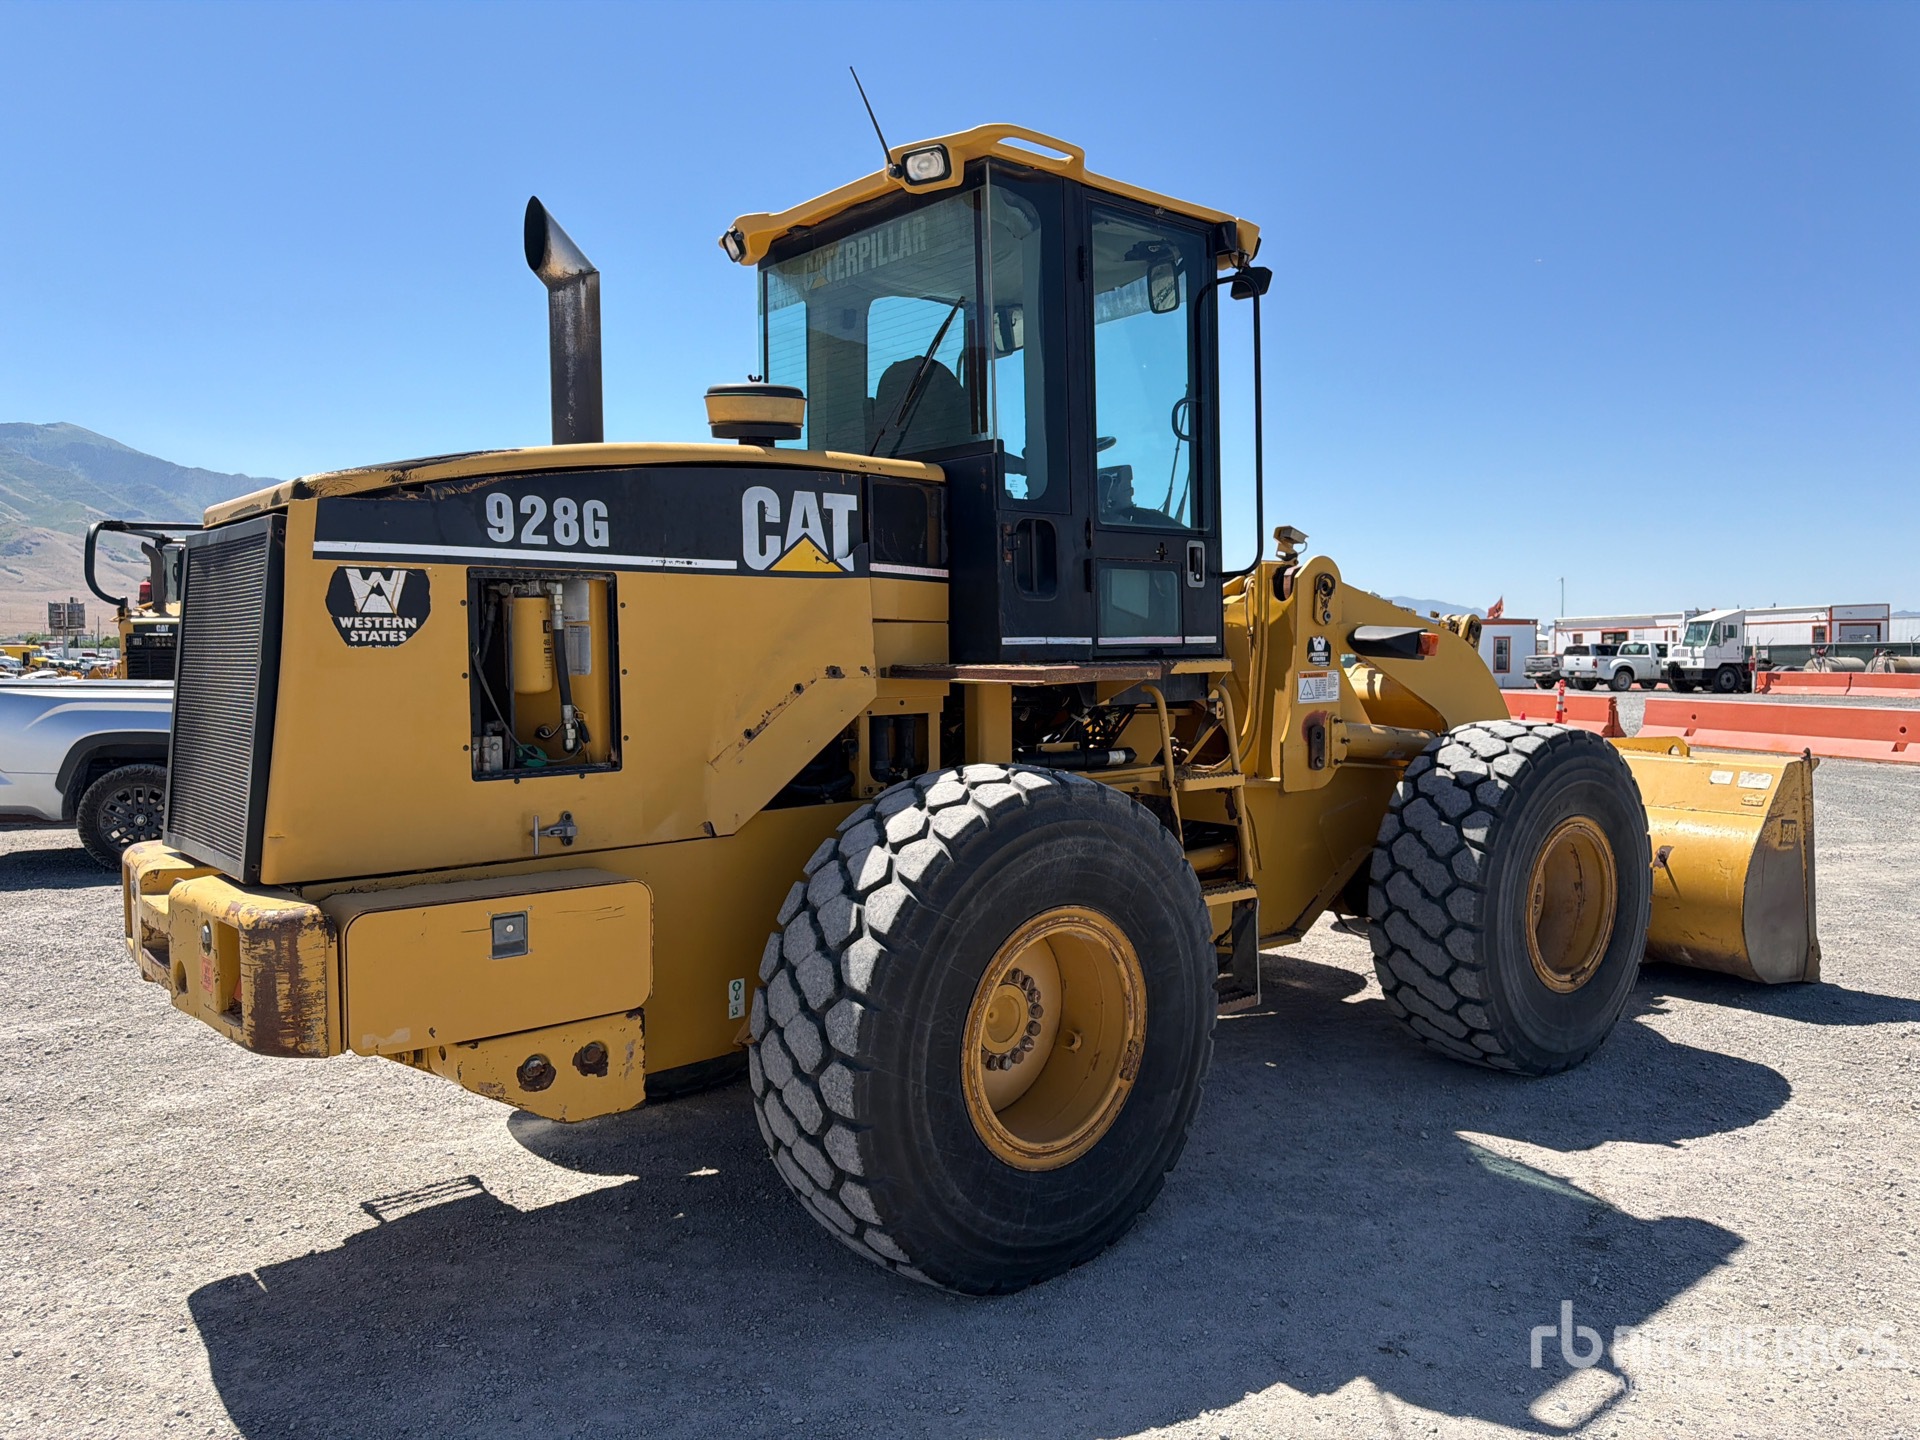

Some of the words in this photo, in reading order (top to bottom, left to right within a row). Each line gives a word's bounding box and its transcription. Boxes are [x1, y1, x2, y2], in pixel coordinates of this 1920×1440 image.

[803, 216, 926, 291] CATERPILLAR
[485, 491, 610, 547] 928G
[741, 486, 858, 572] CAT
[156, 624, 170, 633] CAT
[339, 616, 417, 628] WESTERN
[350, 630, 407, 642] STATES
